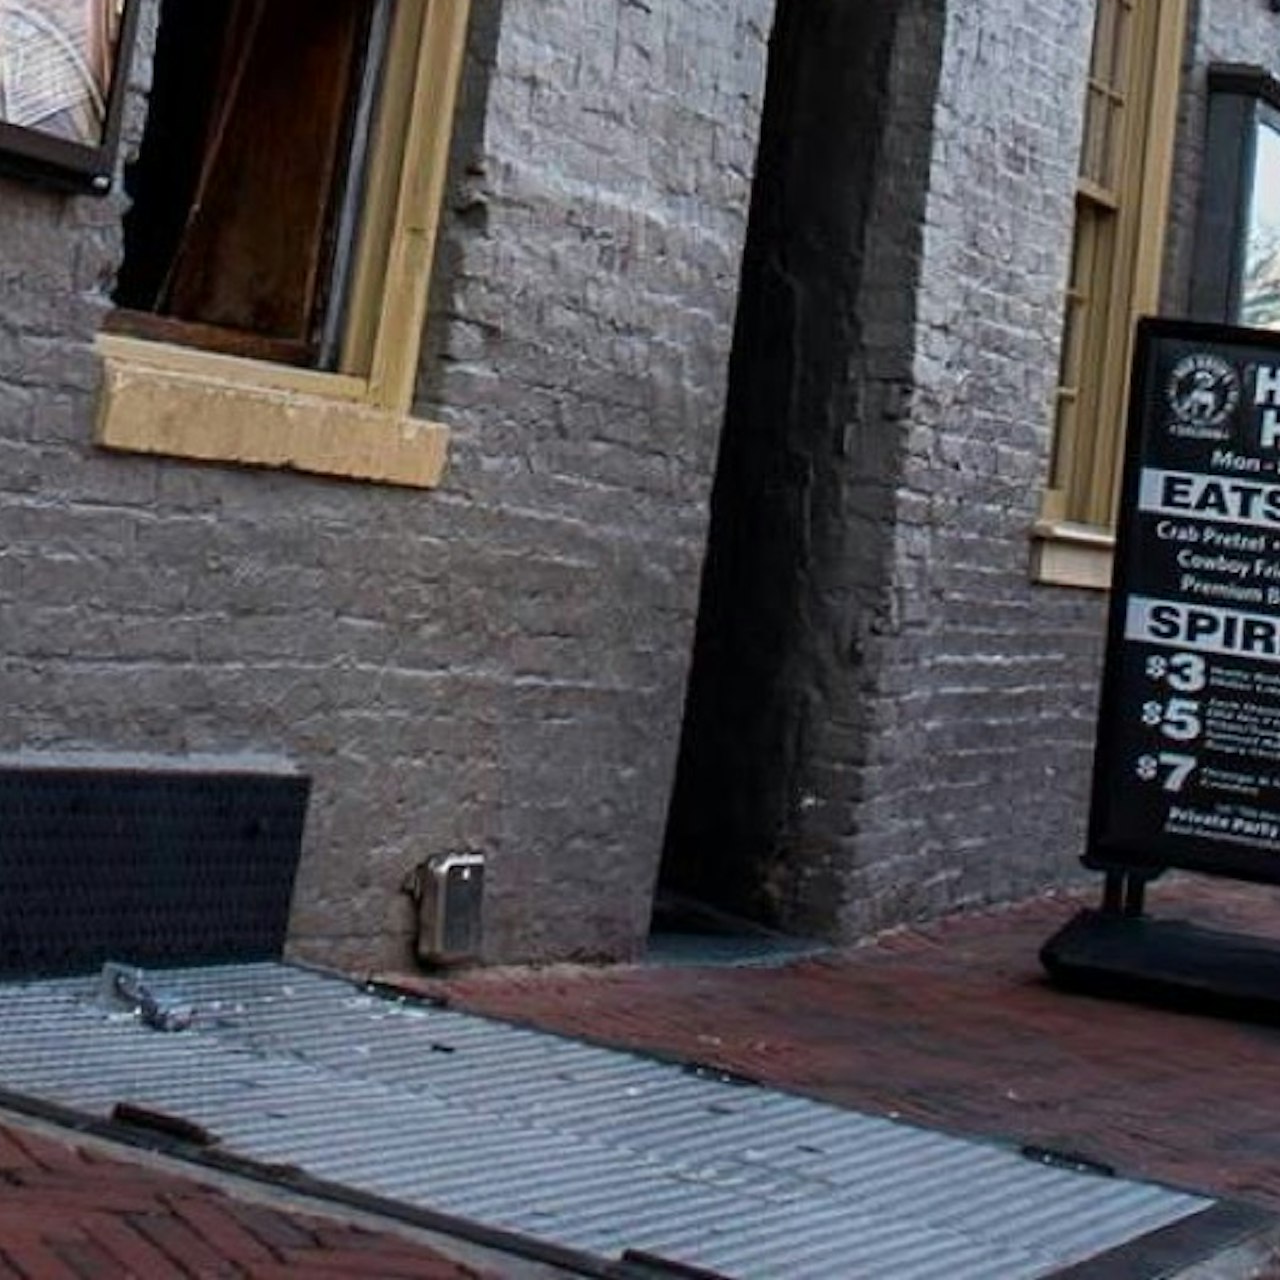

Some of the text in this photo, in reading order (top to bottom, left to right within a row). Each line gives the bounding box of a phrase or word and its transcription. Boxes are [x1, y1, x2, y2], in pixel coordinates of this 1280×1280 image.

[1156, 520, 1199, 542] Crab
[1176, 549, 1249, 579] Cowboy
[1180, 572, 1263, 602] Premium
[1145, 652, 1207, 692] $3
[1141, 698, 1201, 741] $5
[1136, 752, 1197, 792] $7
[1168, 805, 1230, 829] Private
[1231, 816, 1278, 838] Party
